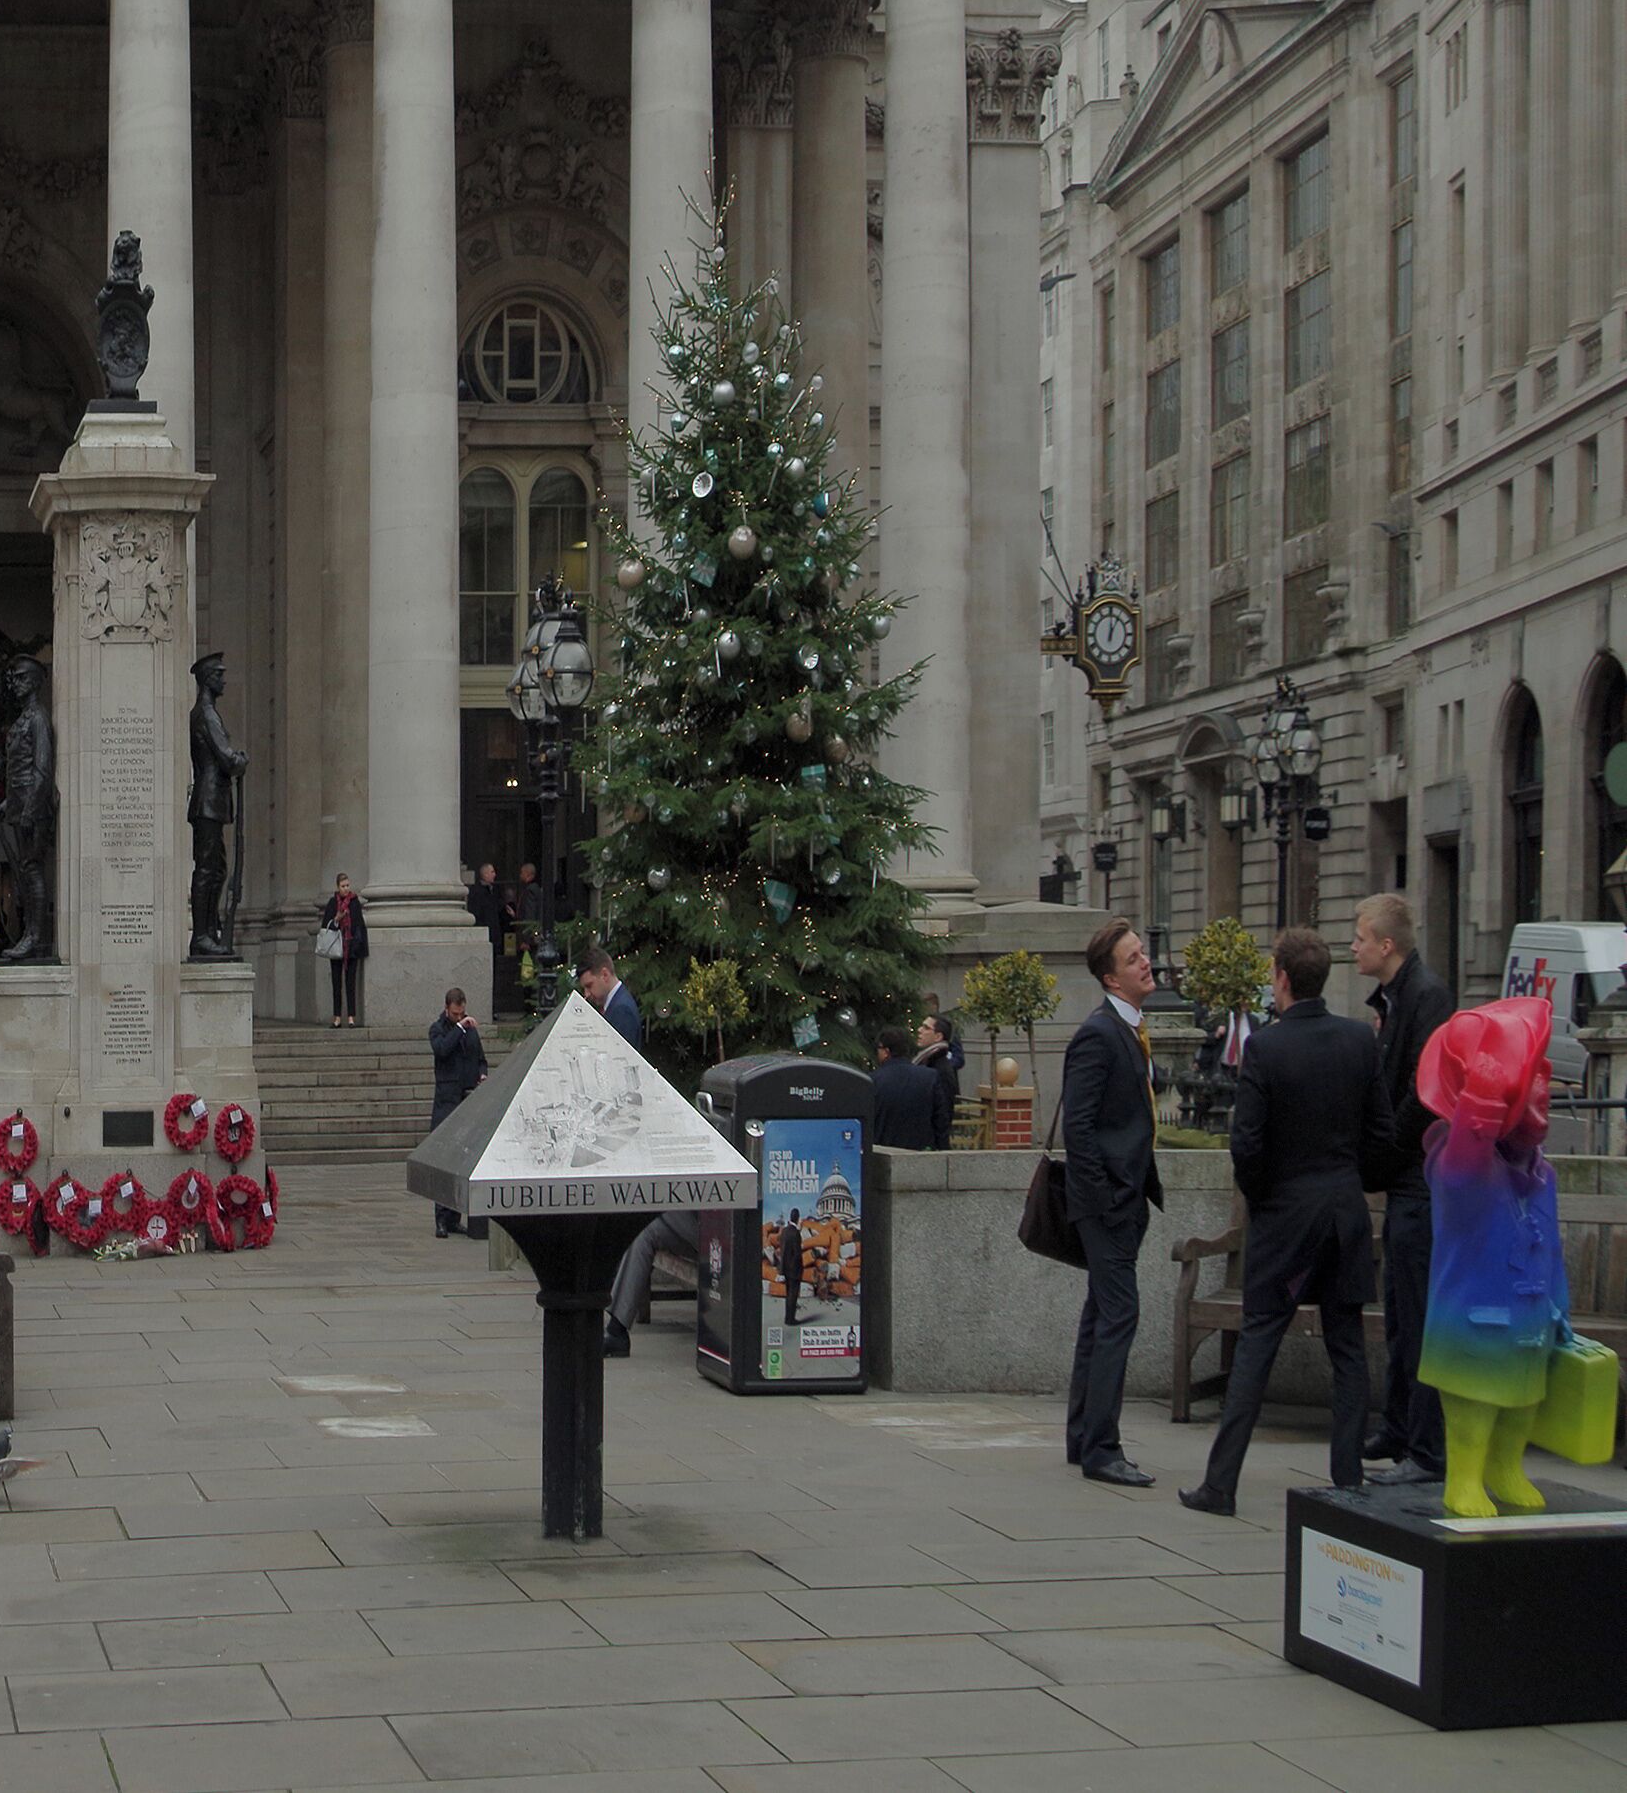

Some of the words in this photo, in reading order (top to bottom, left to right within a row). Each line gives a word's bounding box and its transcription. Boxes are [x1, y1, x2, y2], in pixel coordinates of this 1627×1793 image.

[1506, 956, 1557, 1003] FedEx
[789, 1086, 825, 1096] BigBelly
[768, 1150, 782, 1160] IT'S
[782, 1150, 793, 1160] NO
[768, 1160, 819, 1180] SMALL
[487, 1184, 595, 1209] JUBILEE
[609, 1179, 740, 1205] WALKWAY
[768, 1180, 819, 1194] PROBLEM
[1326, 1542, 1391, 1582] PADDINGTON
